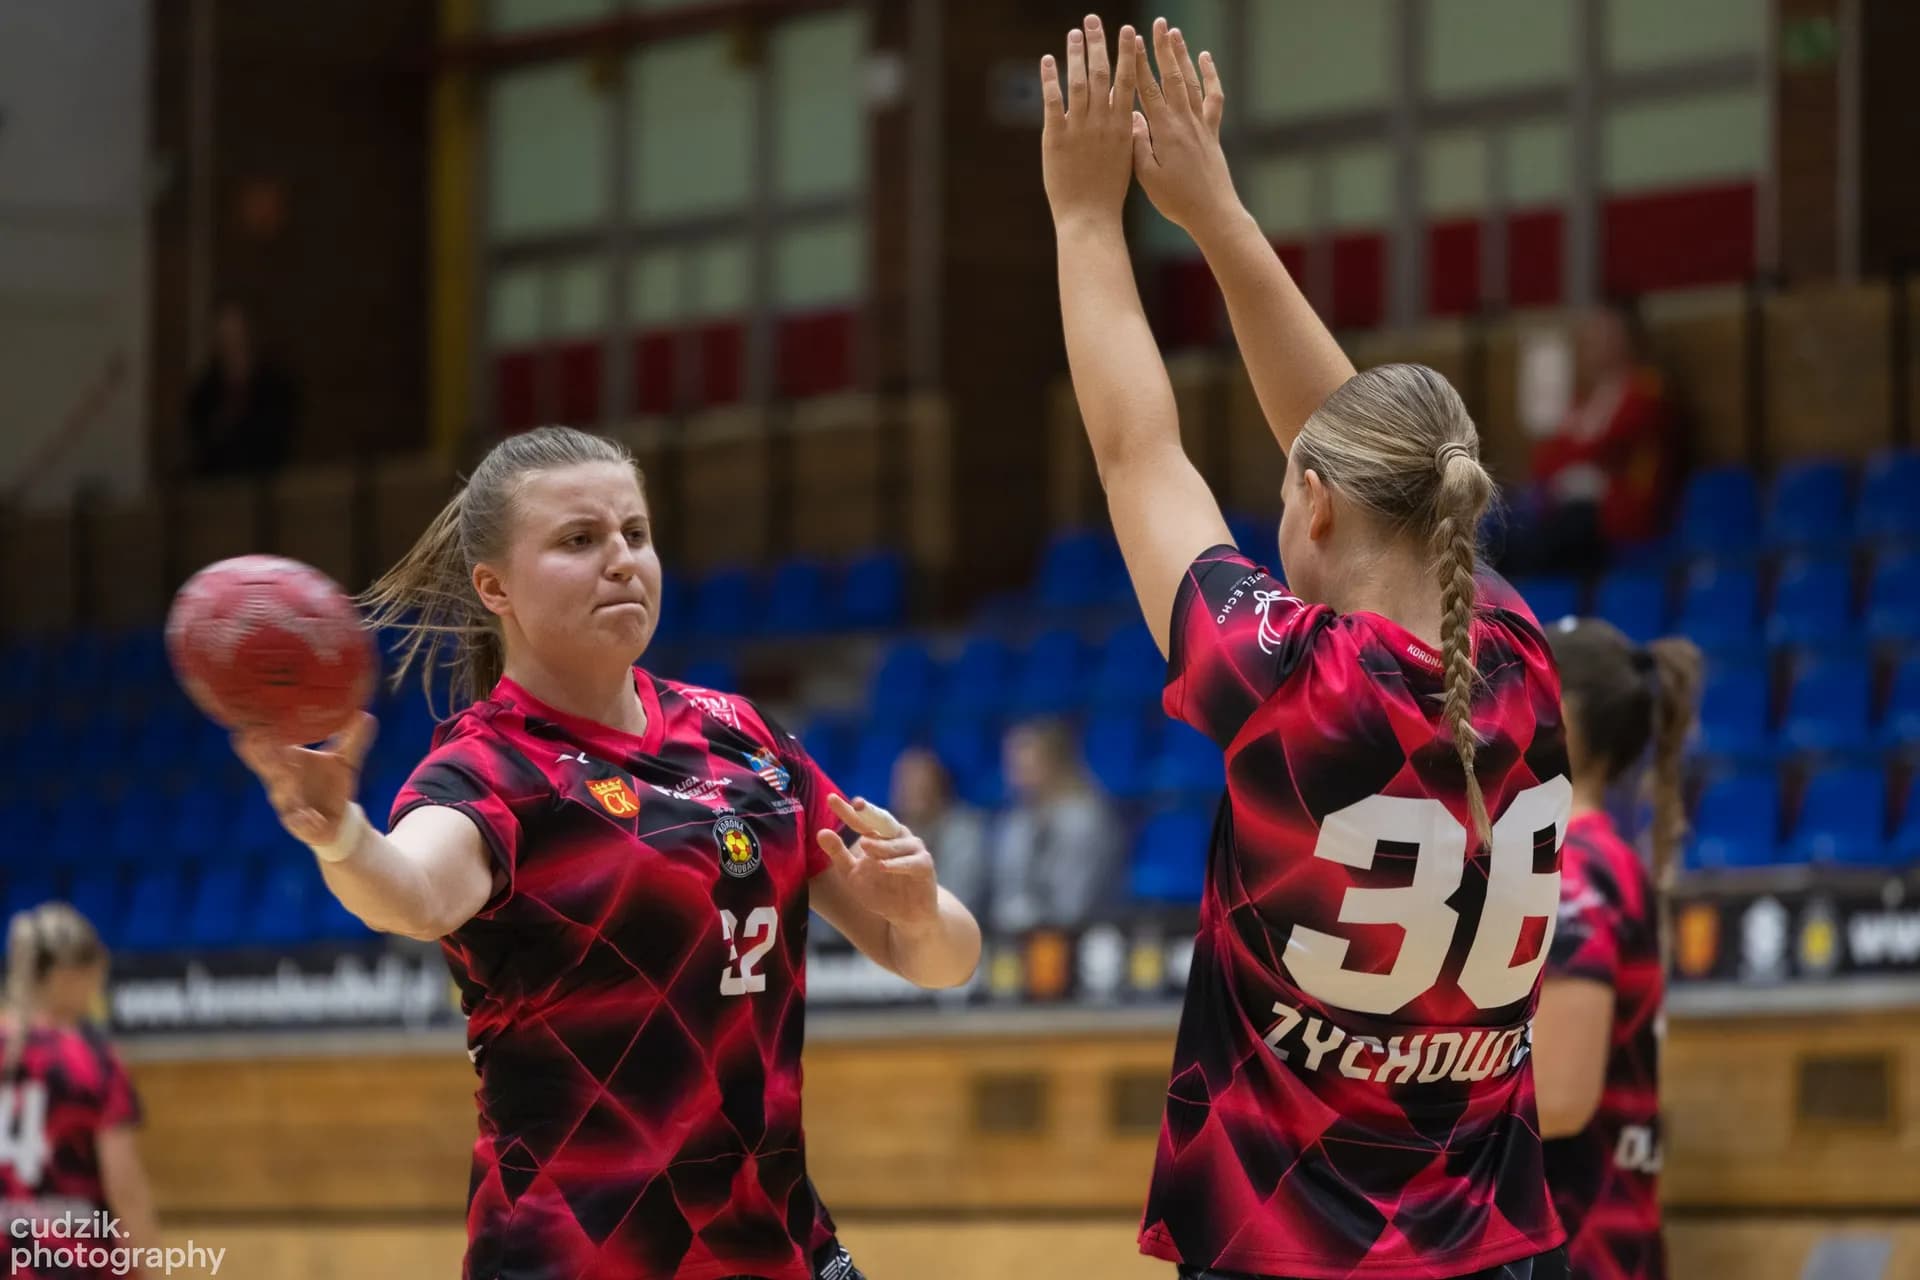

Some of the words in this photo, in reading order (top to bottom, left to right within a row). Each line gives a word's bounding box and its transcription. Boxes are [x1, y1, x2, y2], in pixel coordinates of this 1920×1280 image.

[1217, 589, 1244, 625] ECHO
[675, 775, 700, 792] LIGA
[603, 791, 638, 814] CK
[718, 819, 744, 835] KORONA
[726, 856, 758, 874] HANDBALL
[1282, 773, 1573, 1015] 36
